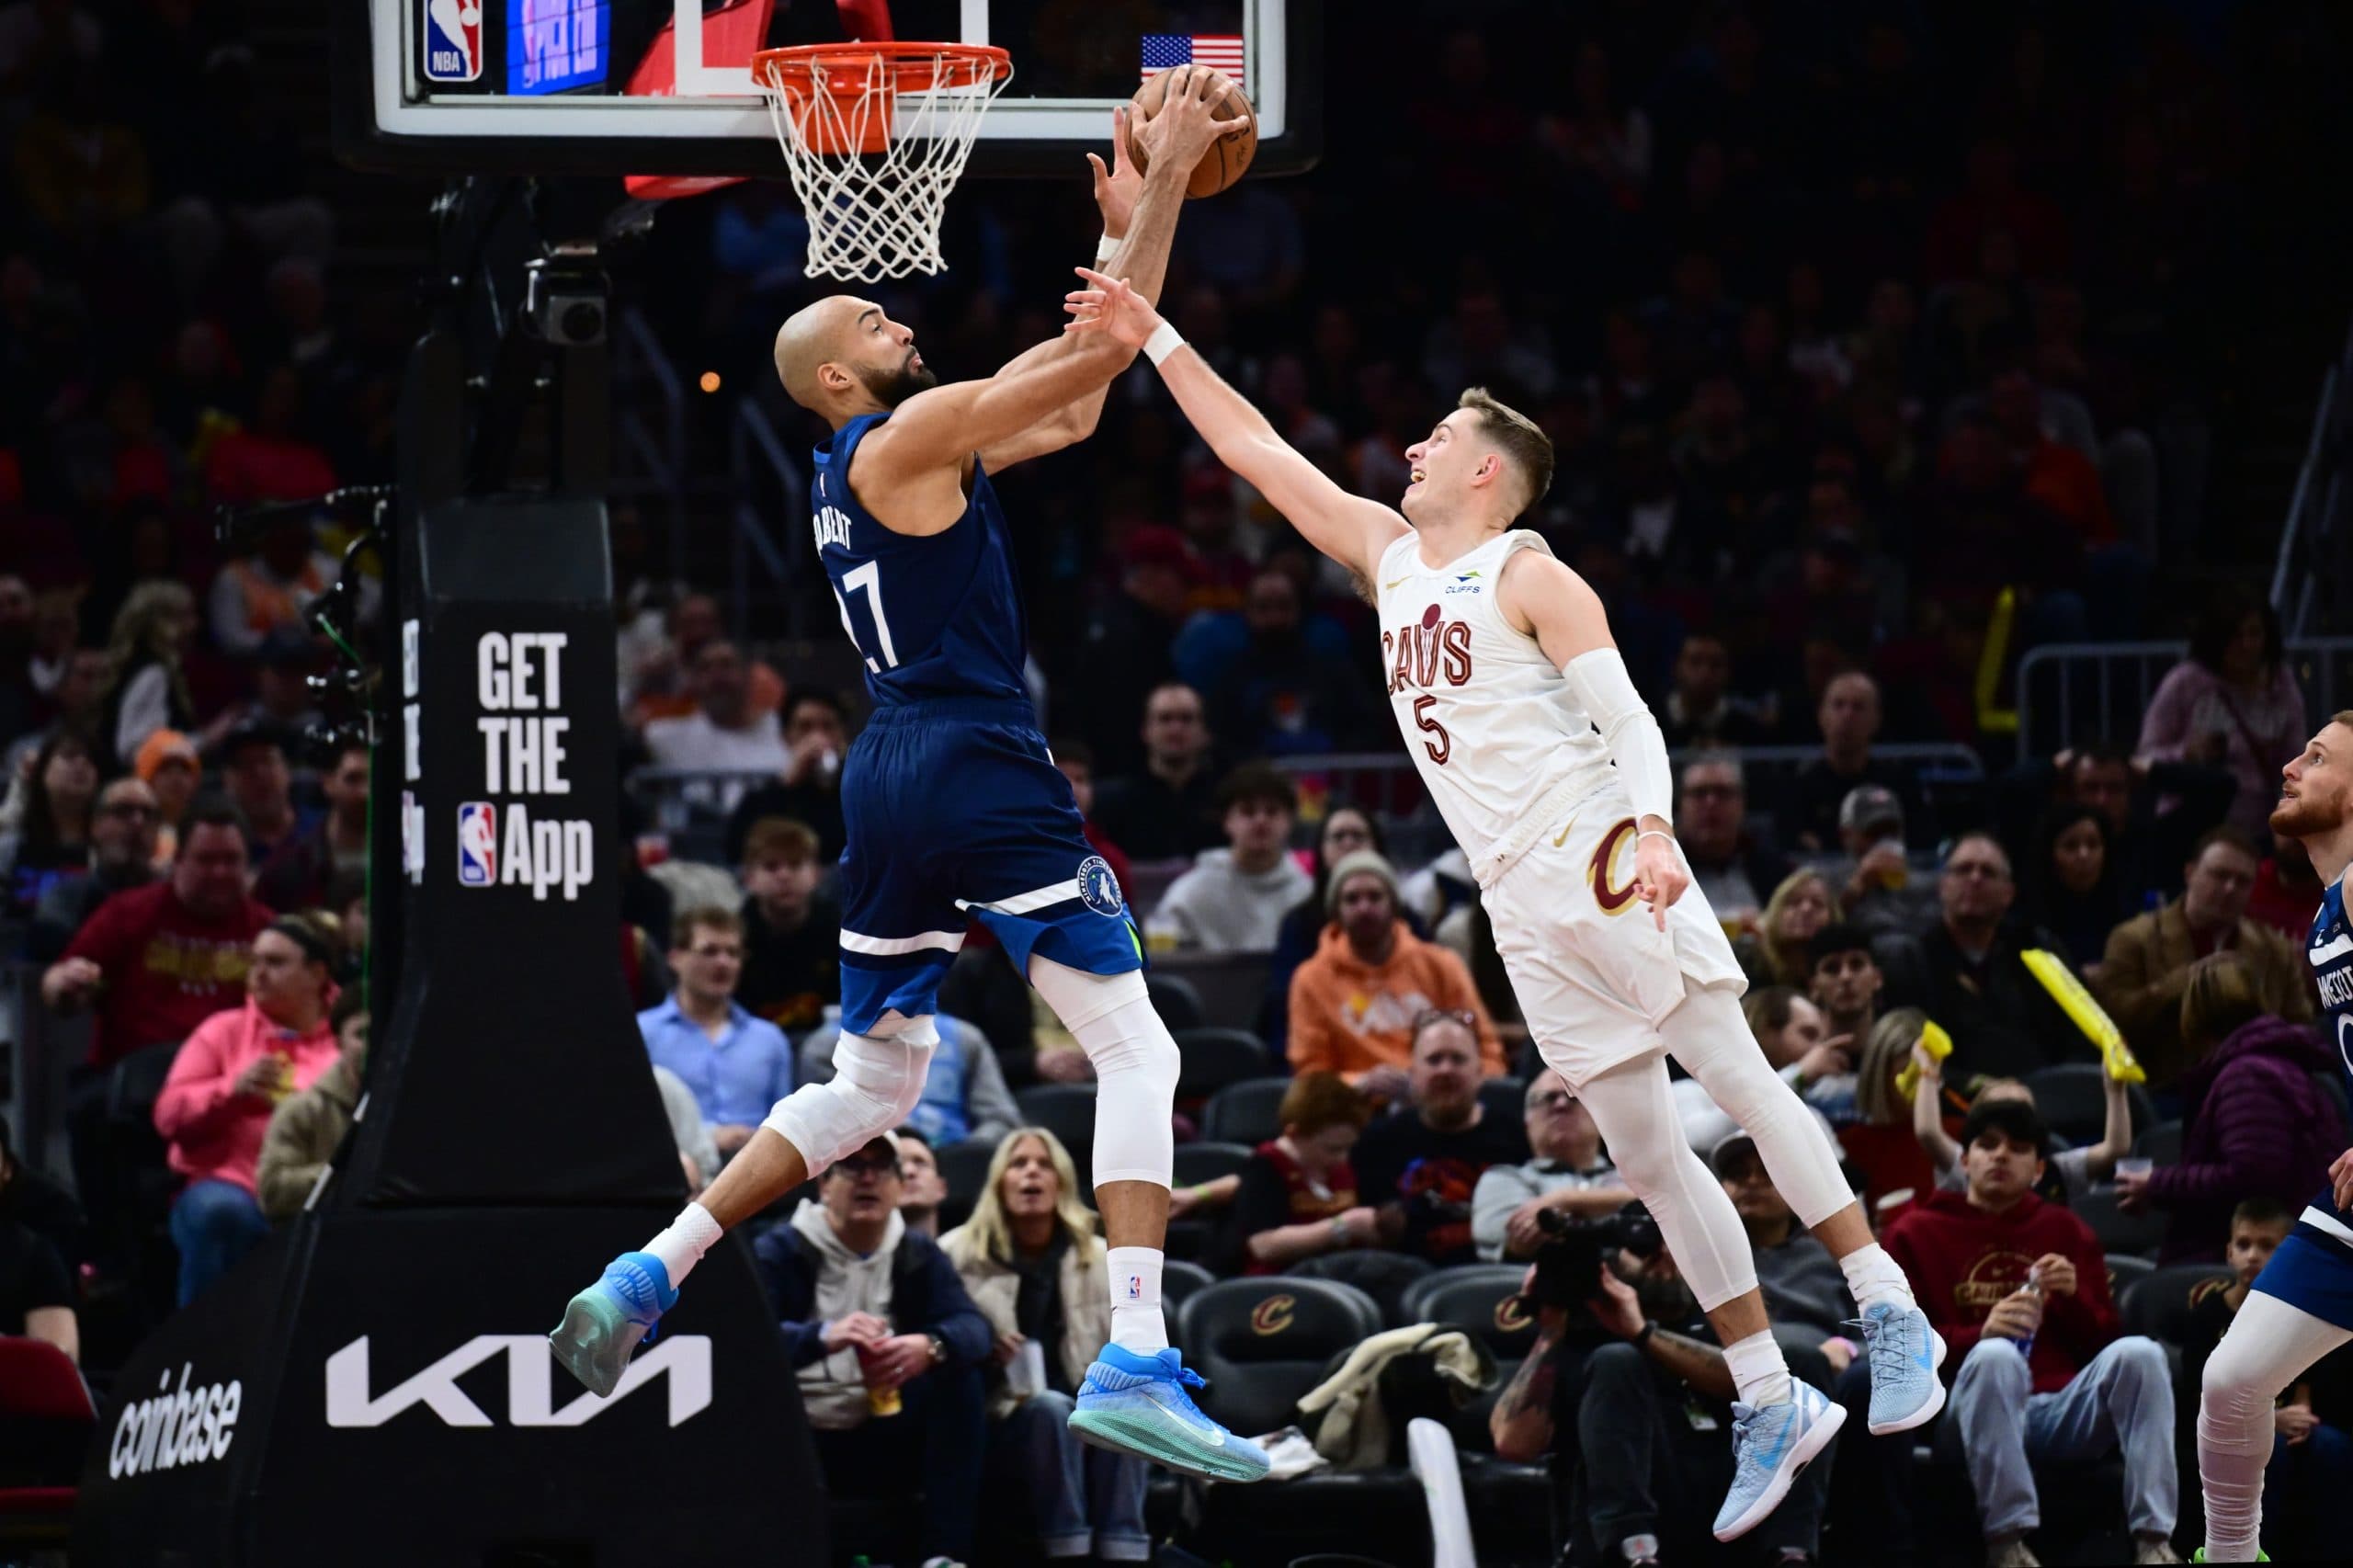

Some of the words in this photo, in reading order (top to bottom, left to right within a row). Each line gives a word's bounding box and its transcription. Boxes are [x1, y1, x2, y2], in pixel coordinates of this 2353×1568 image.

[433, 51, 460, 73] NBA
[813, 505, 852, 561] OBERT
[1445, 585, 1481, 595] CLIFFS
[477, 631, 568, 710] GET
[1381, 619, 1472, 696] CAVS
[477, 716, 571, 795] THE
[1413, 694, 1450, 767] 5
[501, 802, 594, 902] App
[325, 1335, 713, 1427] KIA
[108, 1361, 243, 1481] coinbase
